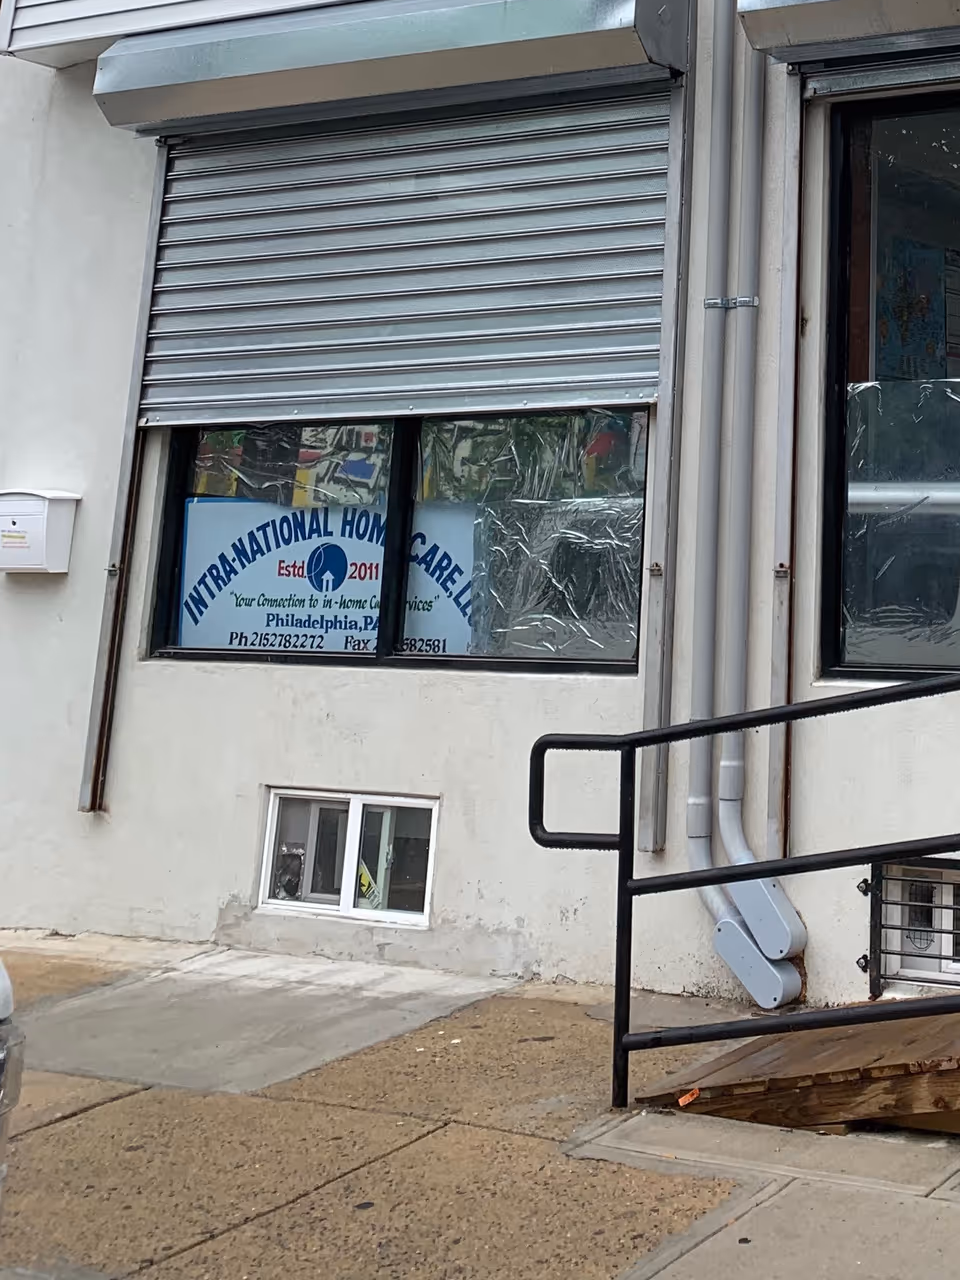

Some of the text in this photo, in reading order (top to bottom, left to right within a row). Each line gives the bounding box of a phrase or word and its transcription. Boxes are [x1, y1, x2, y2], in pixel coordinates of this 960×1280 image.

[183, 507, 334, 626] INTRA-NATIONAL
[340, 507, 387, 547] HOM
[277, 559, 380, 581] Estd. 2011
[256, 594, 306, 609] Connection
[308, 595, 319, 608] to
[228, 631, 248, 647] Ph
[249, 632, 325, 650] 2152782272
[343, 635, 371, 651] Fax
